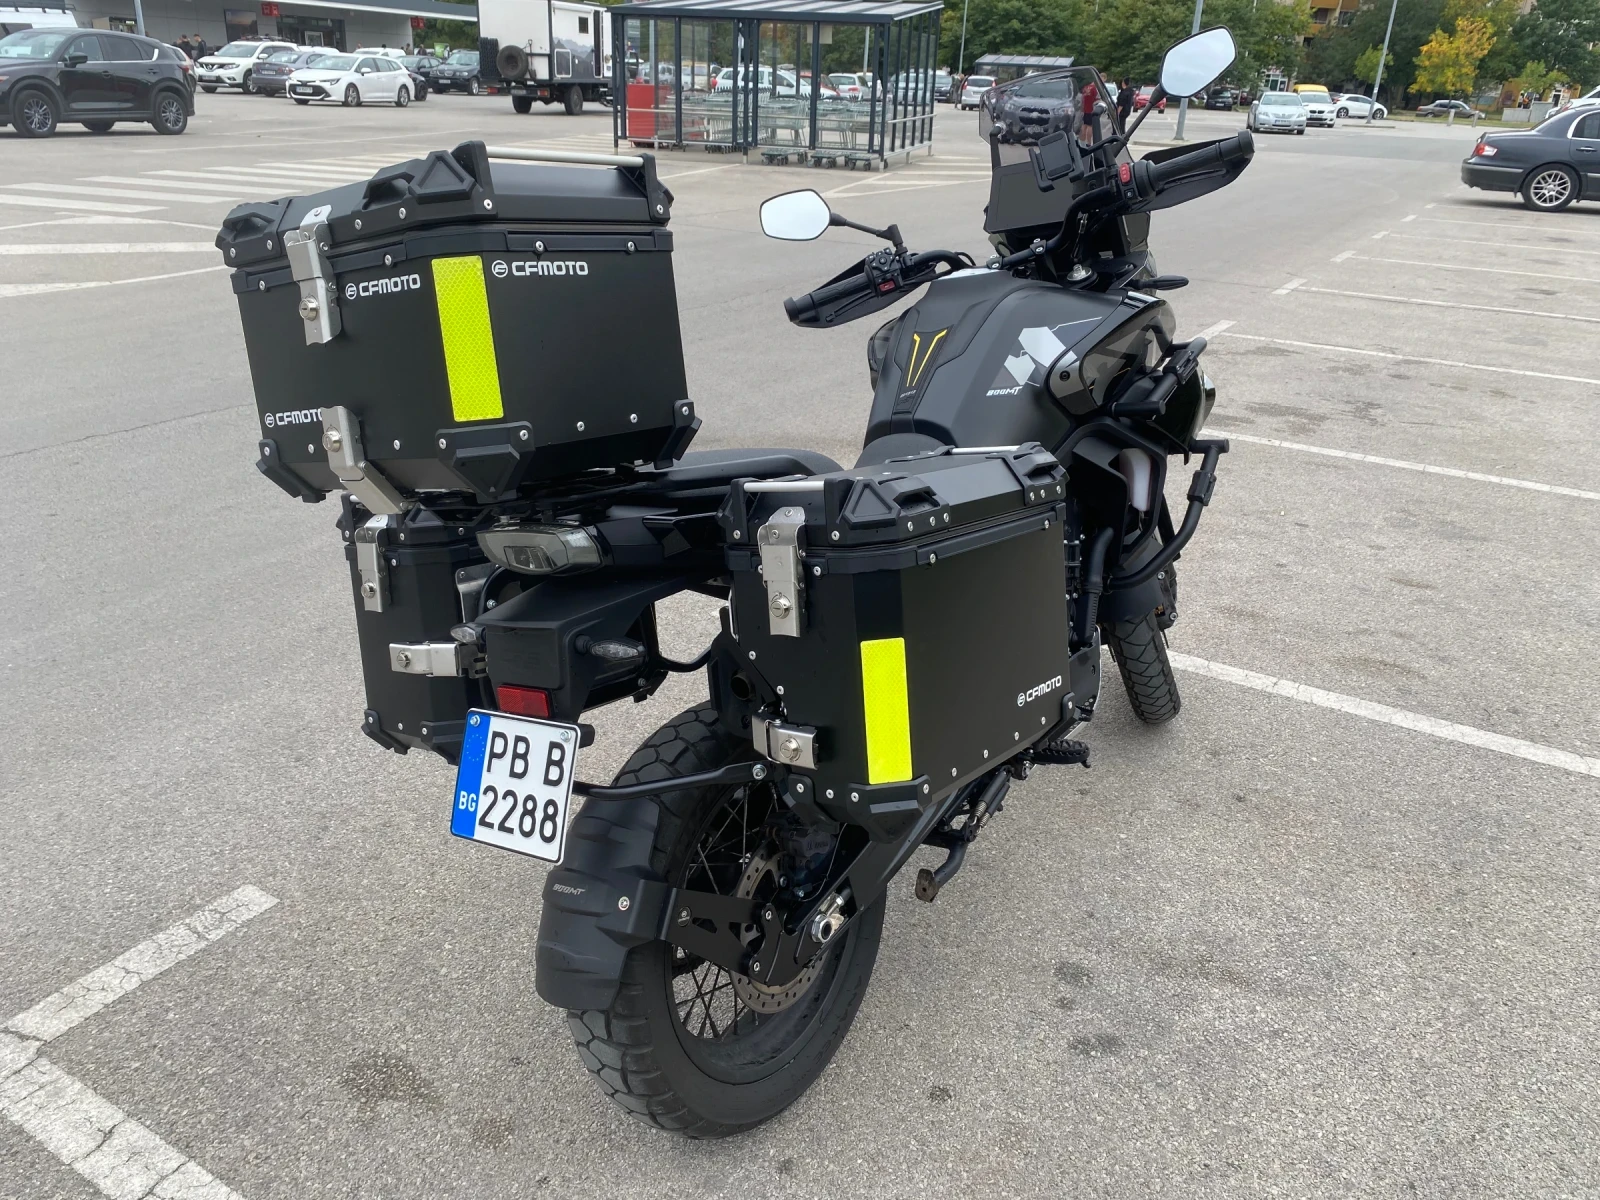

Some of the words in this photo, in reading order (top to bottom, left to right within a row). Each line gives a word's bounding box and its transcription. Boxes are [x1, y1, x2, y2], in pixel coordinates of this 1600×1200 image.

[512, 260, 589, 276] CFMOTO
[359, 274, 421, 297] CFMOTO
[1026, 675, 1062, 702] CFMOTO
[486, 730, 531, 779] PB
[543, 740, 567, 787] B
[458, 790, 477, 812] BG
[478, 784, 560, 844] 2288
